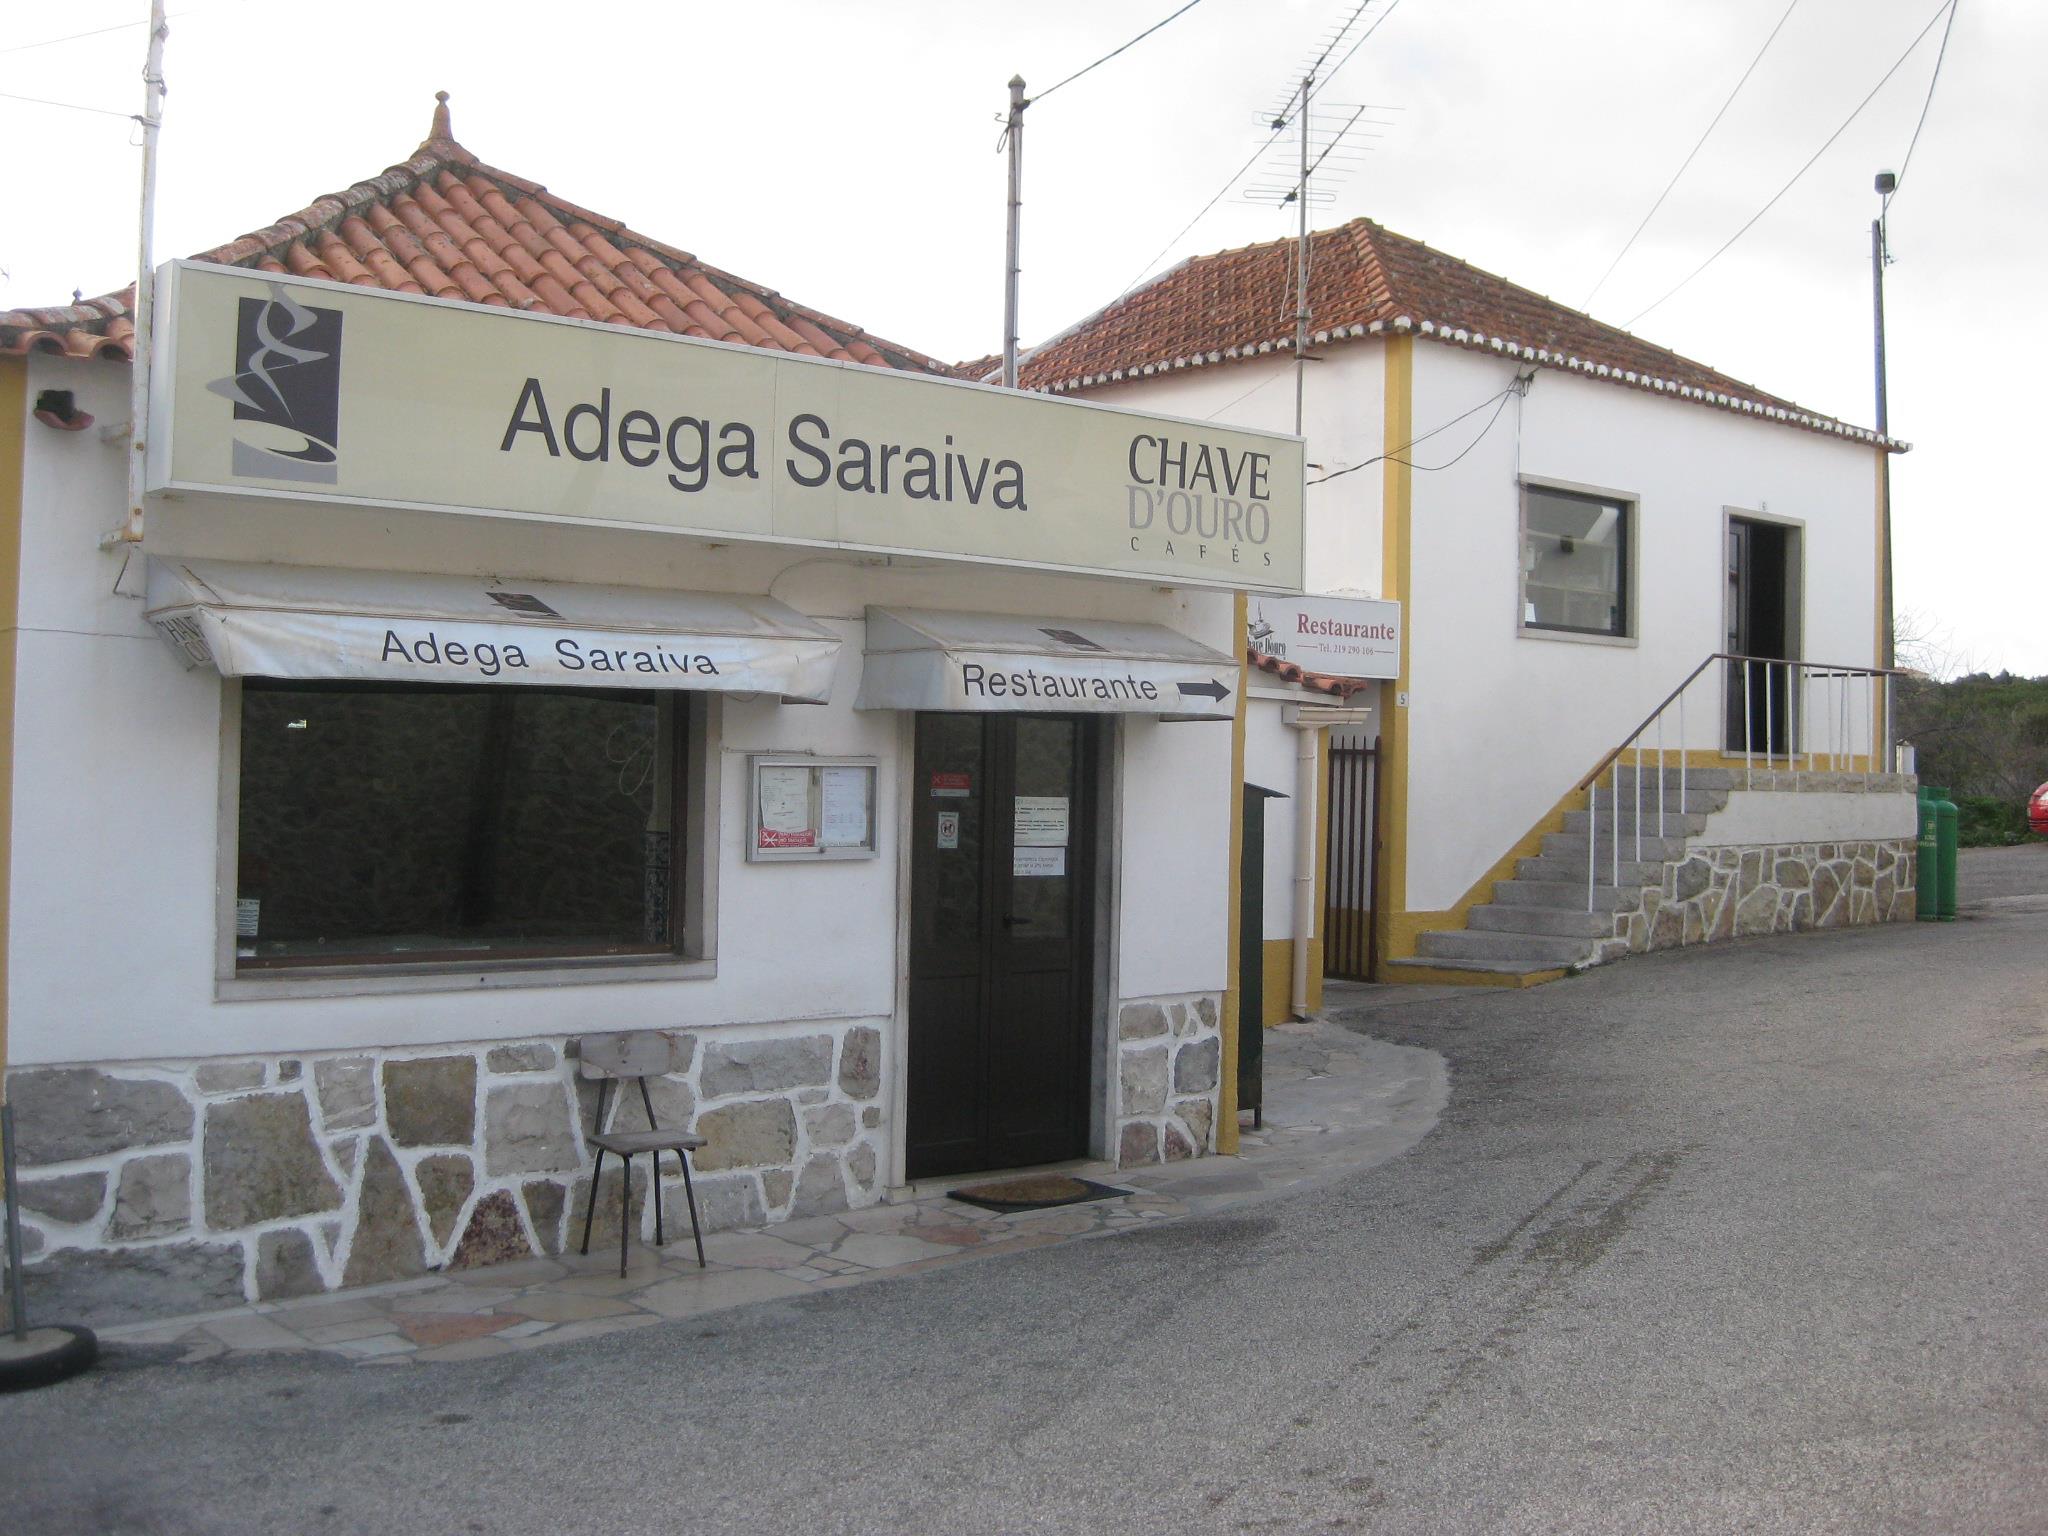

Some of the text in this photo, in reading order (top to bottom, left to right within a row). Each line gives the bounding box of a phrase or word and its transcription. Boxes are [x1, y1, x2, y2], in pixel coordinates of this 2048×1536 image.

[500, 377, 1028, 512] Adega Saraiva
[1128, 434, 1271, 501] CHAVE
[1126, 484, 1270, 545] D'OURO
[1130, 536, 1271, 567] CAFÉS
[1296, 613, 1395, 641] Restaurante
[381, 630, 720, 676] Adega Saraiva
[962, 664, 1158, 701] Restaurante
